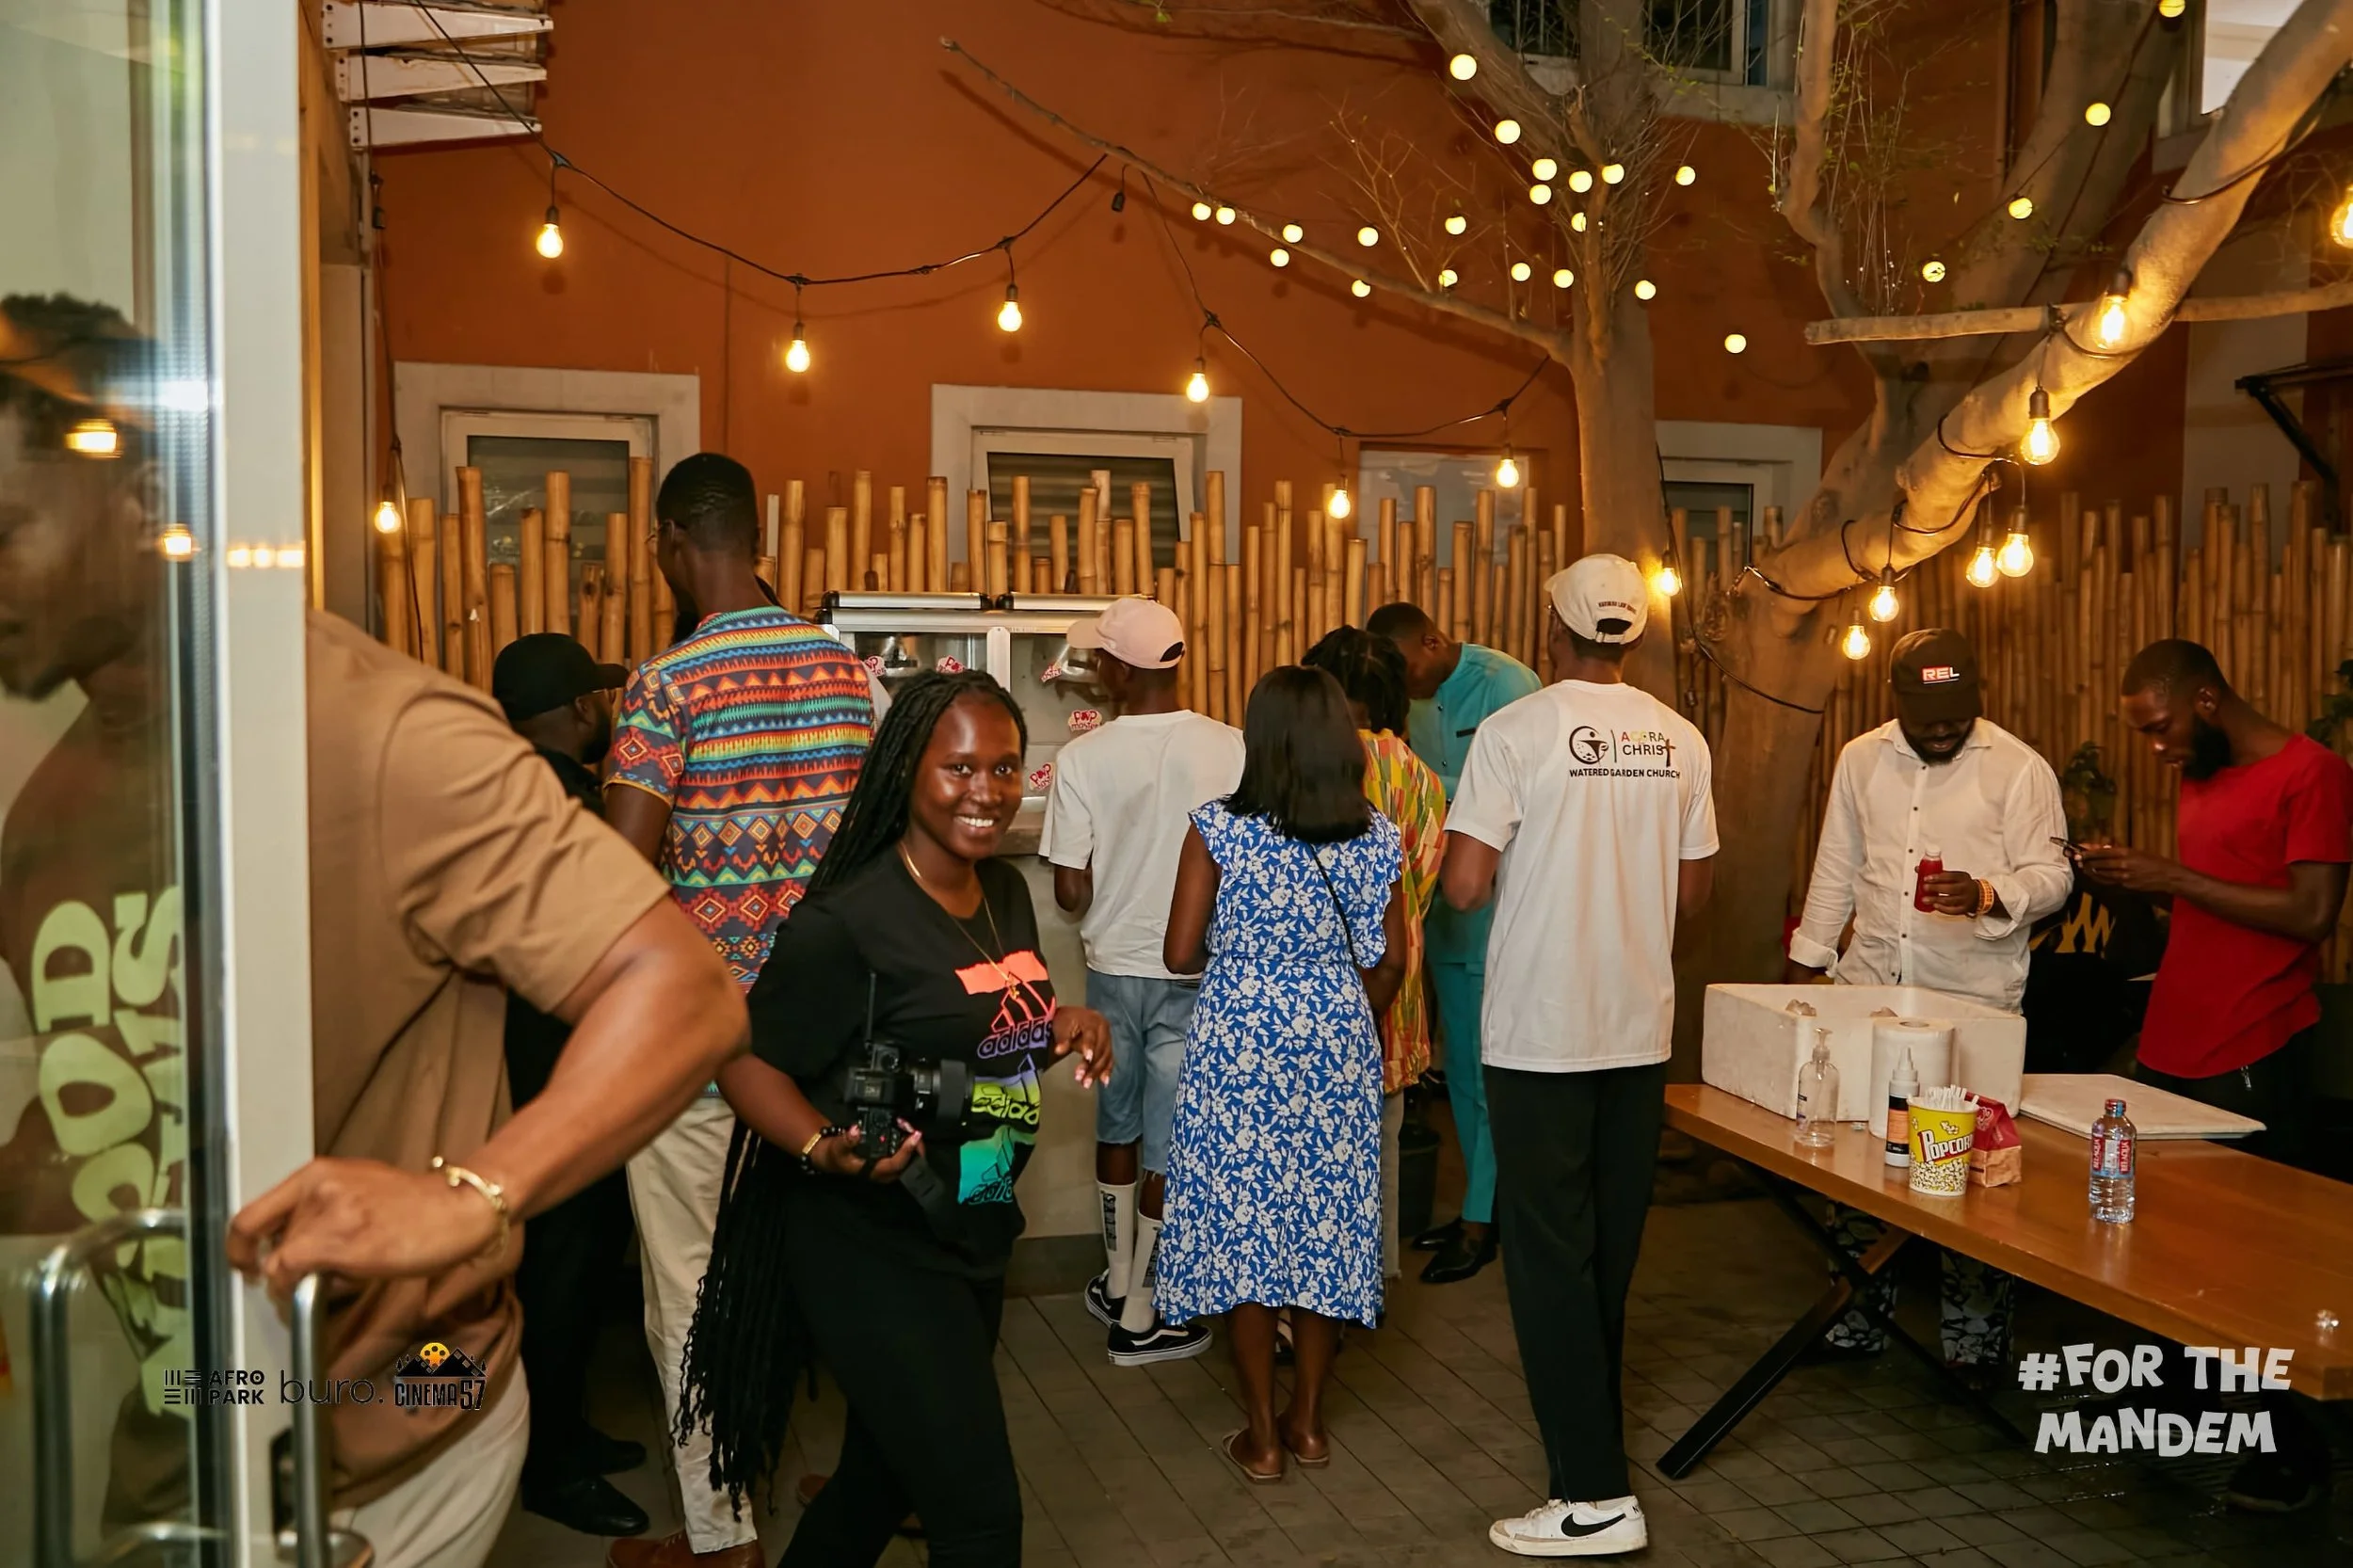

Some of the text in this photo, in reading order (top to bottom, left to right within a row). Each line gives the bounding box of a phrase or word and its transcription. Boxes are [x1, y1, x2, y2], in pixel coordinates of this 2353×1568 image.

[1922, 666, 1961, 681] REL
[1621, 731, 1666, 743] ACCRA
[1569, 768, 1681, 779] WATERED GARDEN CHURCH
